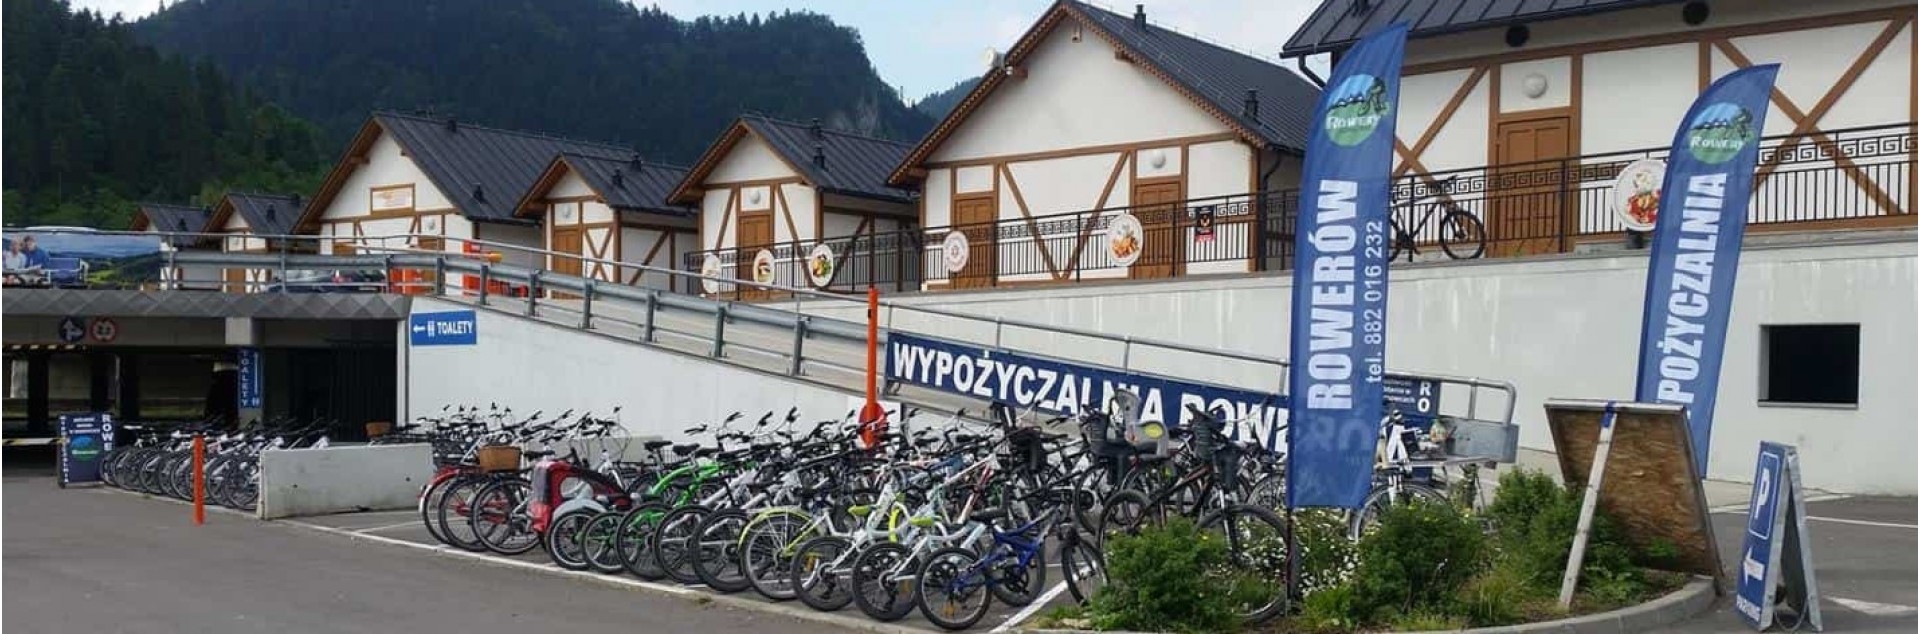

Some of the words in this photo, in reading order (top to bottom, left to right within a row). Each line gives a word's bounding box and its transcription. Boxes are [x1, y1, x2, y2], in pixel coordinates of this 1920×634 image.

[1366, 221, 1383, 259] 232
[1307, 180, 1358, 409] ROWERÓW
[1365, 265, 1382, 302] 016
[1657, 172, 1727, 404] POŻYCZALNIA
[437, 320, 473, 335] TOALETY
[1365, 308, 1382, 345] 882
[894, 341, 1164, 424] WYPOŻYCZALNA
[1365, 351, 1382, 383] tel.
[1754, 468, 1770, 519] P
